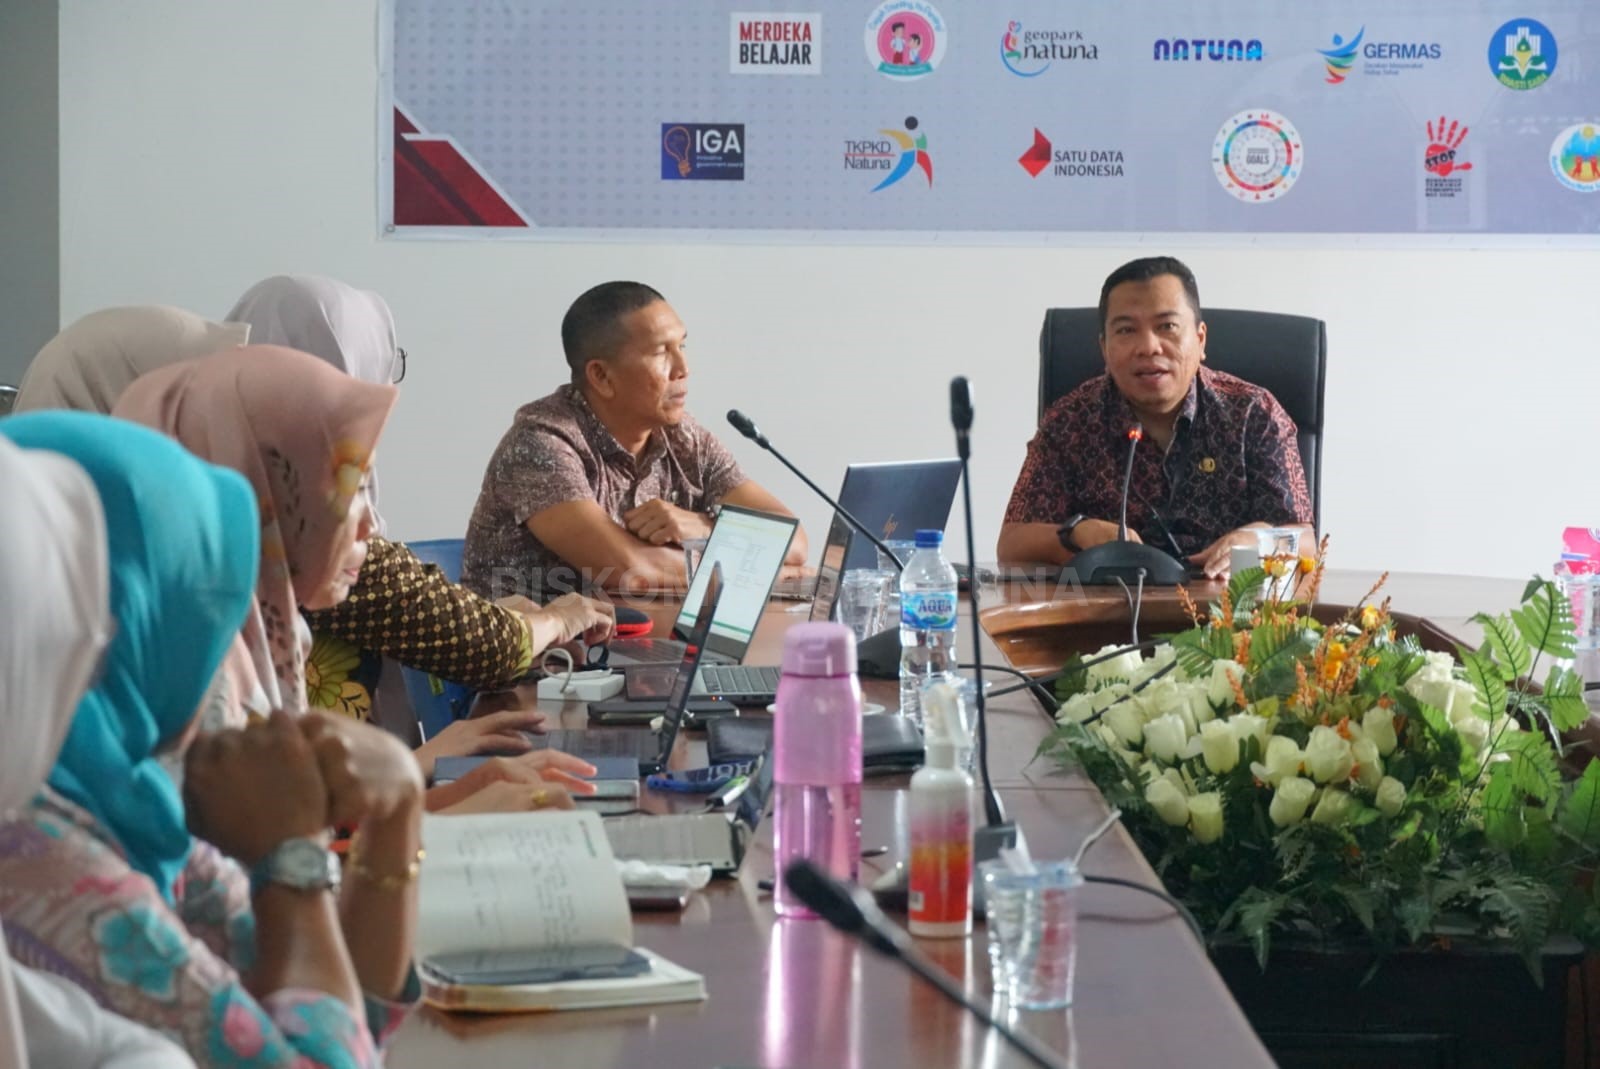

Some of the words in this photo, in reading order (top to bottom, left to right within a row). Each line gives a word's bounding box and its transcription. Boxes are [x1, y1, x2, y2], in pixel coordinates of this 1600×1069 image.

[739, 21, 812, 42] MERDEKA
[1024, 30, 1084, 43] geopark
[739, 43, 812, 65] BELAJAR
[1024, 41, 1099, 60] natuna
[1153, 39, 1263, 61] NATUNA
[1363, 43, 1441, 60] GERMAS
[695, 129, 742, 154] IGA
[844, 140, 892, 154] TKPKD
[844, 156, 891, 170] Natuna
[1054, 150, 1087, 163] SATU
[1090, 150, 1124, 163] DATA
[1246, 152, 1270, 165] GOALS
[1425, 150, 1457, 169] STOP
[1054, 164, 1124, 177] INDONESIA
[918, 599, 953, 613] AQUA
